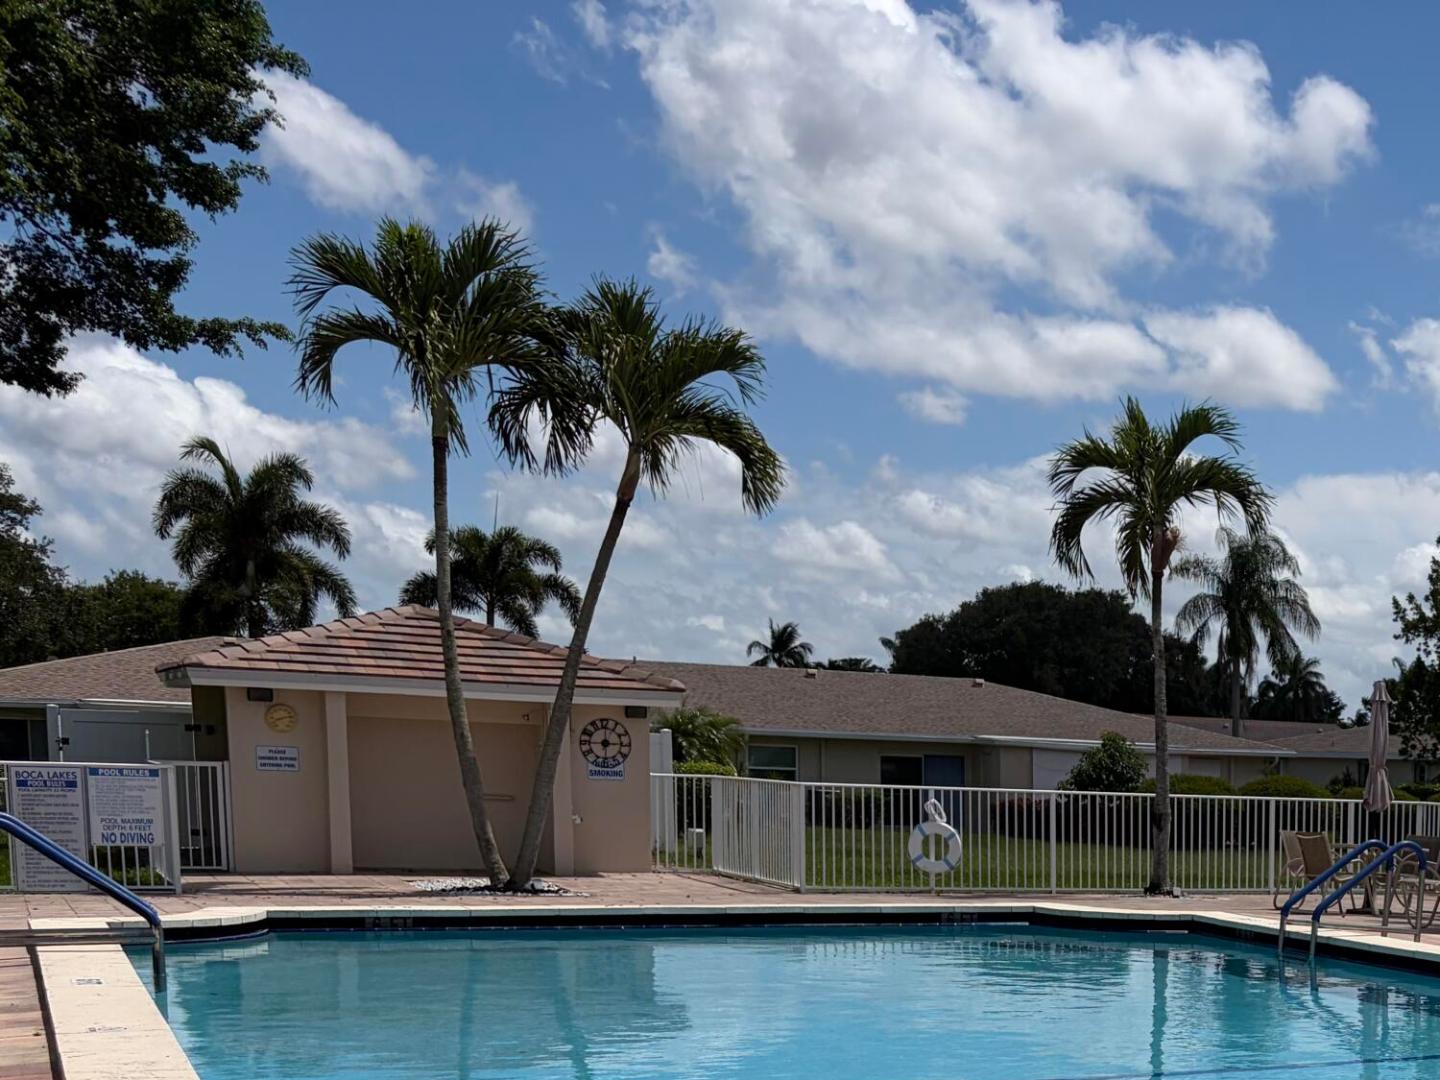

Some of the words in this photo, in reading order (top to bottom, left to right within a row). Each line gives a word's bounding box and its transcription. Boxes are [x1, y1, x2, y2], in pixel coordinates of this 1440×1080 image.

[15, 770, 44, 779] BOCA
[47, 771, 77, 780] LAKES
[98, 768, 121, 776] POOL
[123, 769, 150, 777] RULES
[589, 769, 623, 777] SMOKING
[101, 832, 117, 843] NO
[120, 833, 155, 844] DIVING
